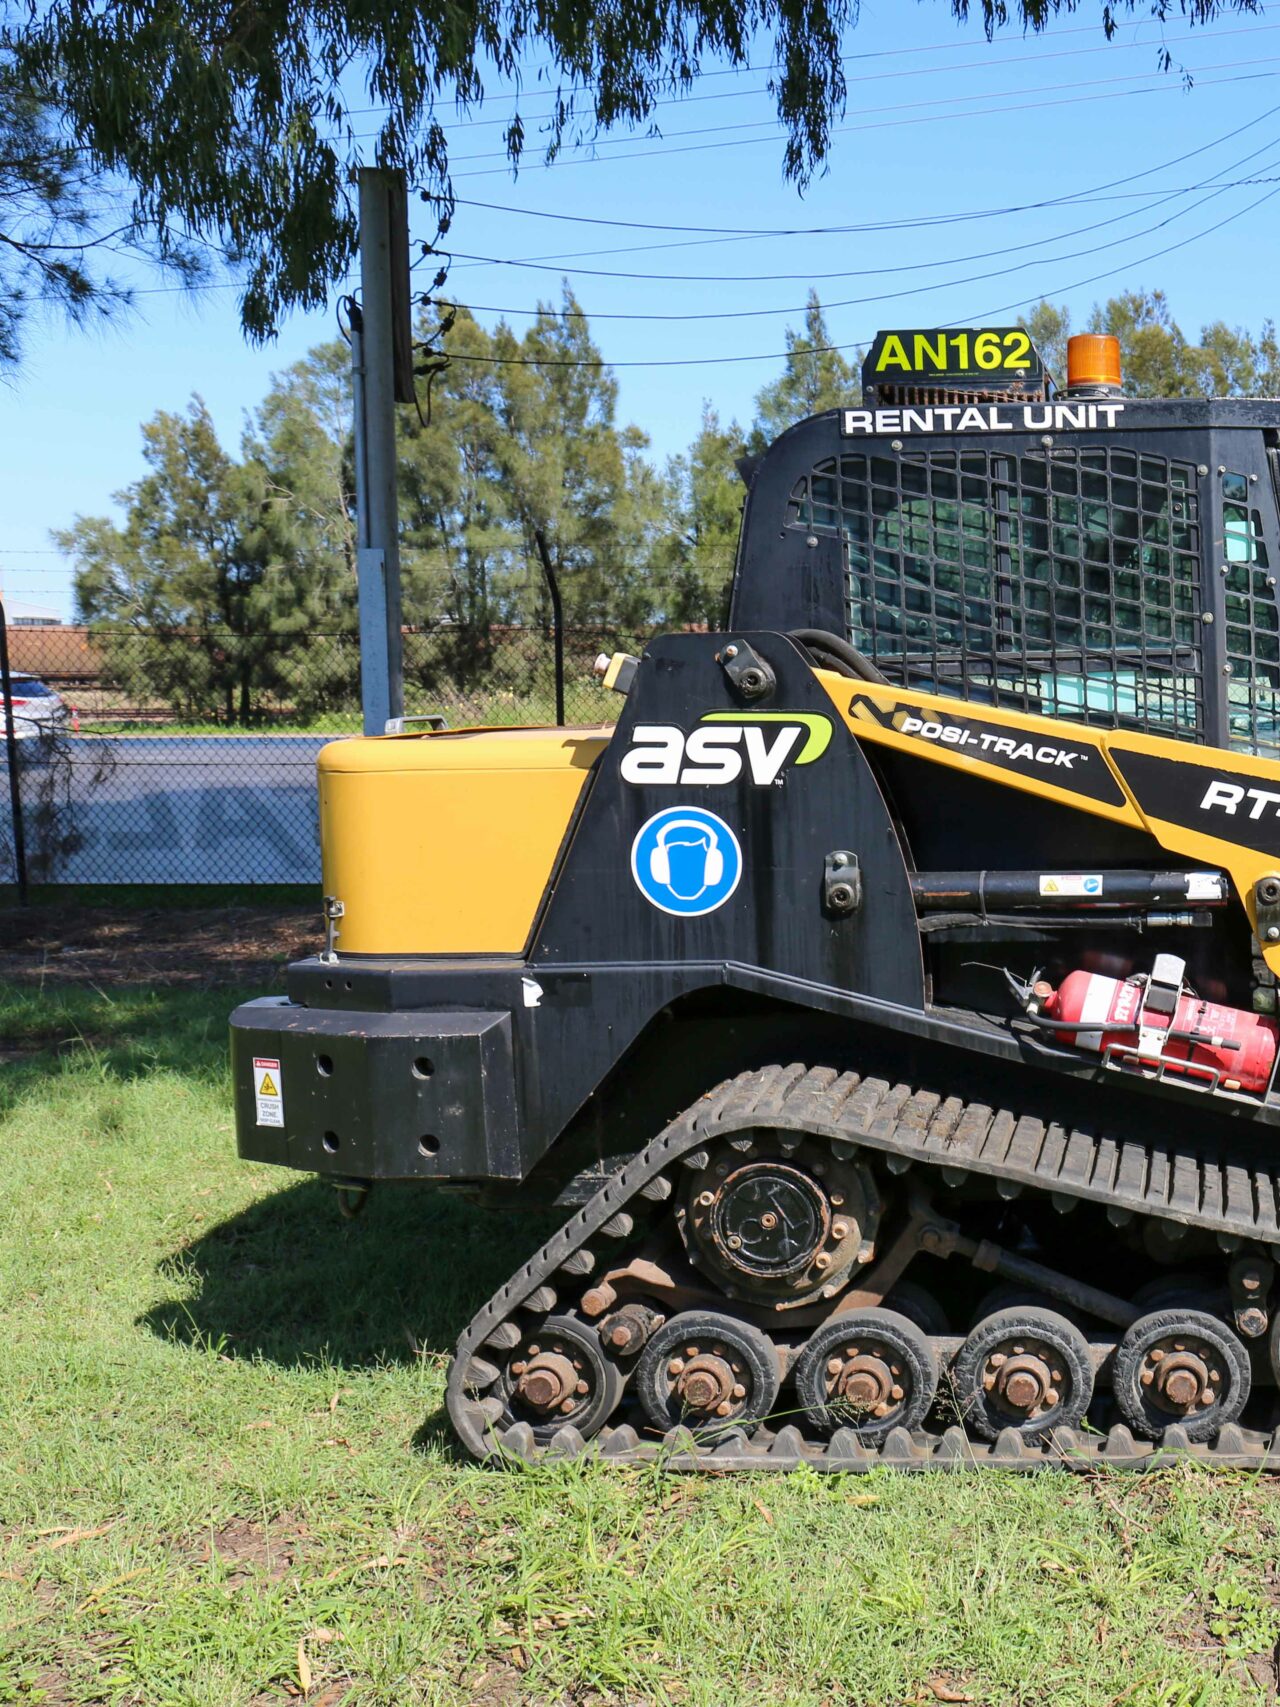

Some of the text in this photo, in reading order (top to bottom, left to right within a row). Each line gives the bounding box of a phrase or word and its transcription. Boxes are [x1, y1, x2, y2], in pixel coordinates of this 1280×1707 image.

[875, 331, 1031, 371] AN162
[844, 404, 1125, 434] RENTAL UNIT
[620, 726, 802, 785] asv
[900, 717, 1079, 769] POSI-TRACK
